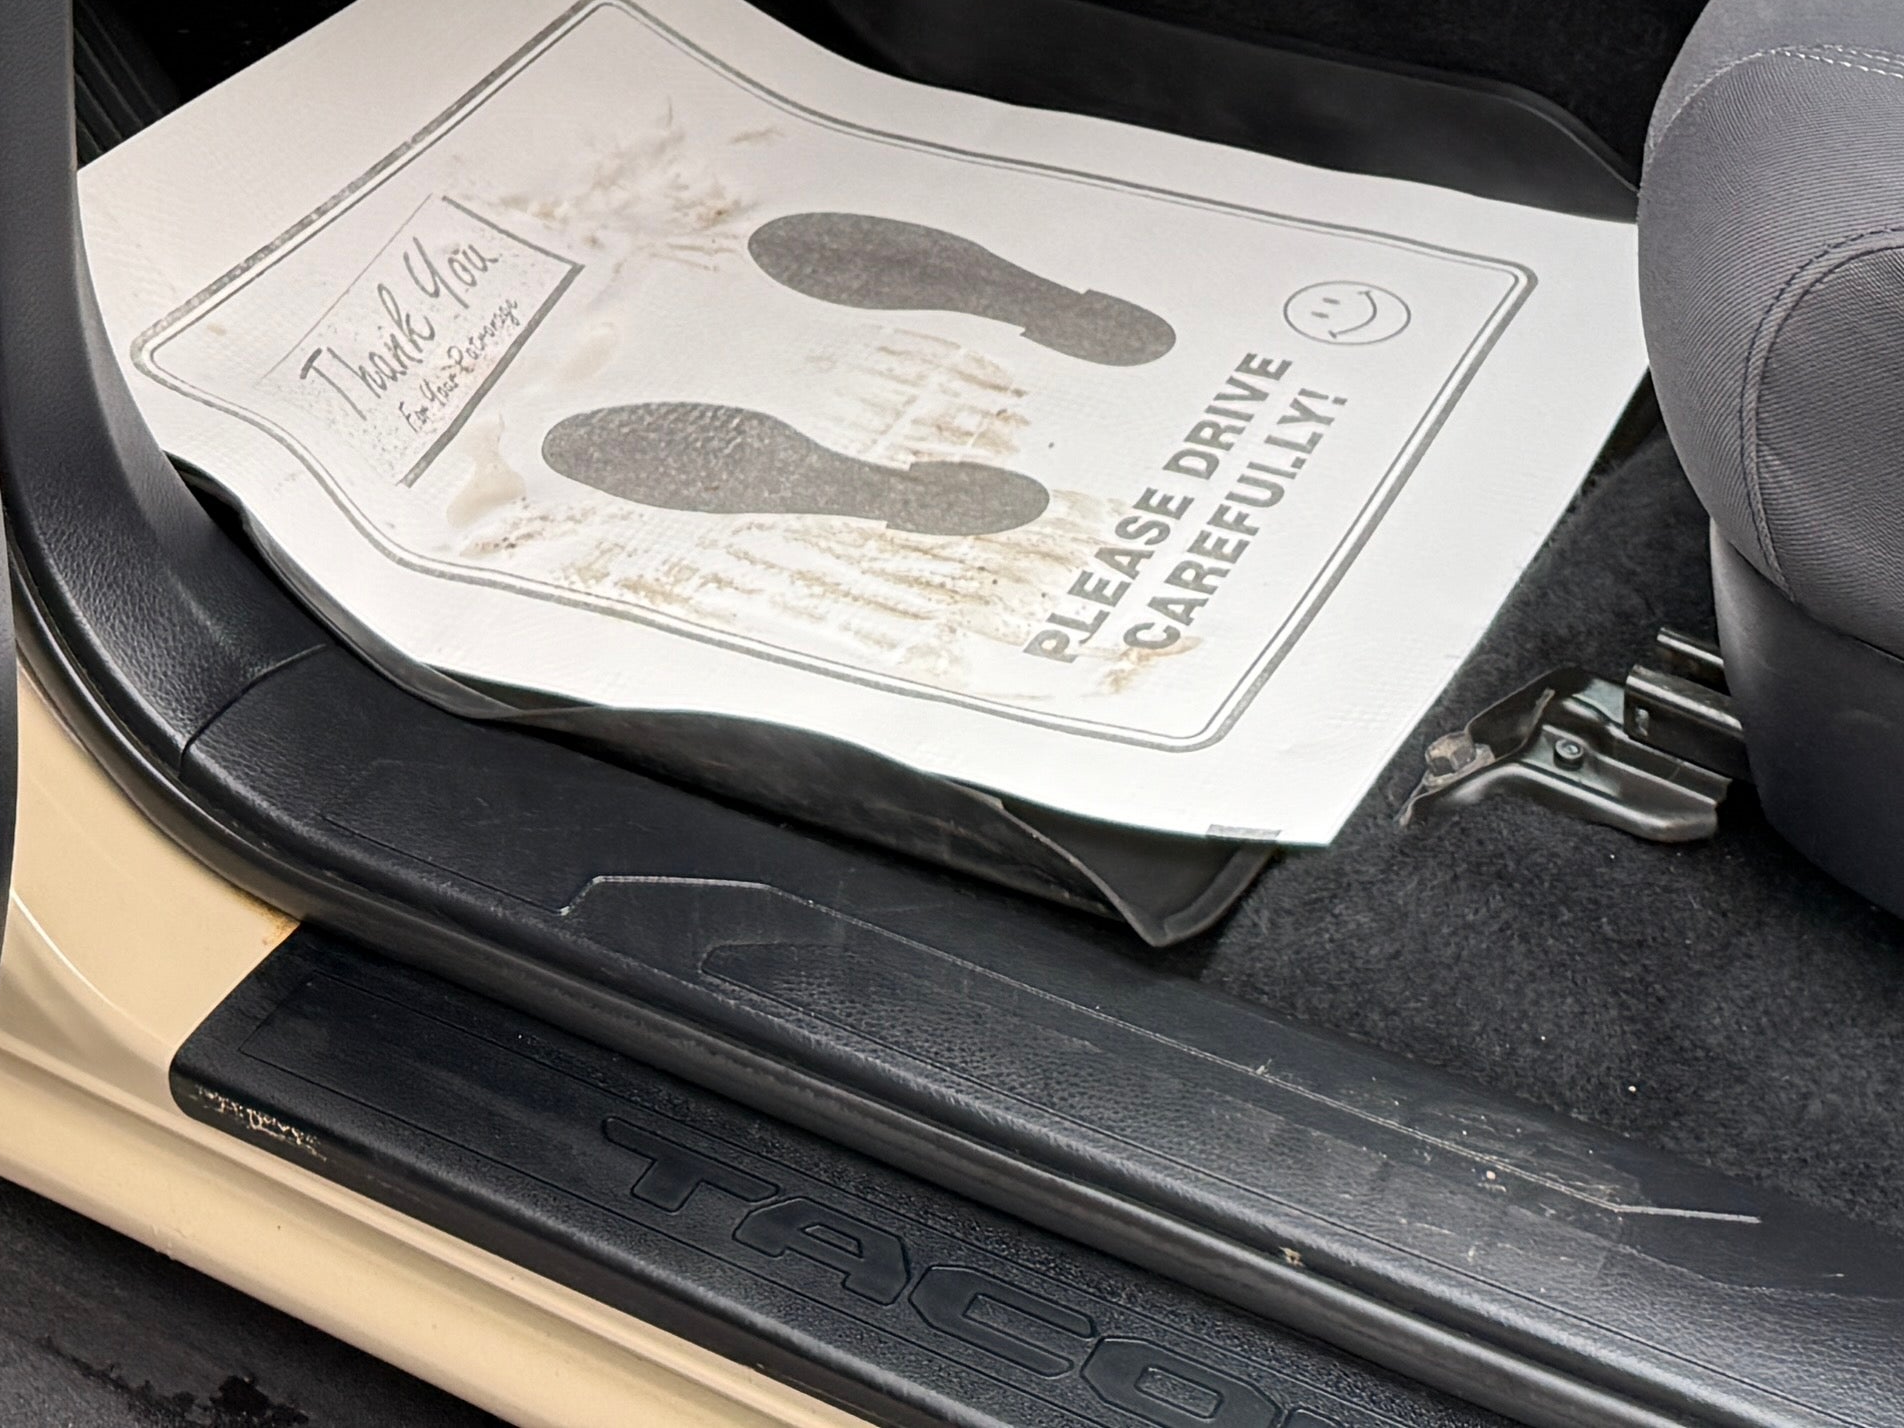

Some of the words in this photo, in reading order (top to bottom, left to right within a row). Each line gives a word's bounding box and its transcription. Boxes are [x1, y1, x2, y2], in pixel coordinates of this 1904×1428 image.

[300, 283, 436, 420] Thank
[404, 237, 499, 309] You
[398, 401, 430, 433] For
[419, 372, 459, 407] Your
[440, 299, 521, 374] Patronage
[1022, 487, 1195, 664] PLEASE
[1162, 353, 1293, 481] DRIVE
[1122, 388, 1348, 651] CAREFULLY!
[600, 1114, 1345, 1428] TACO
